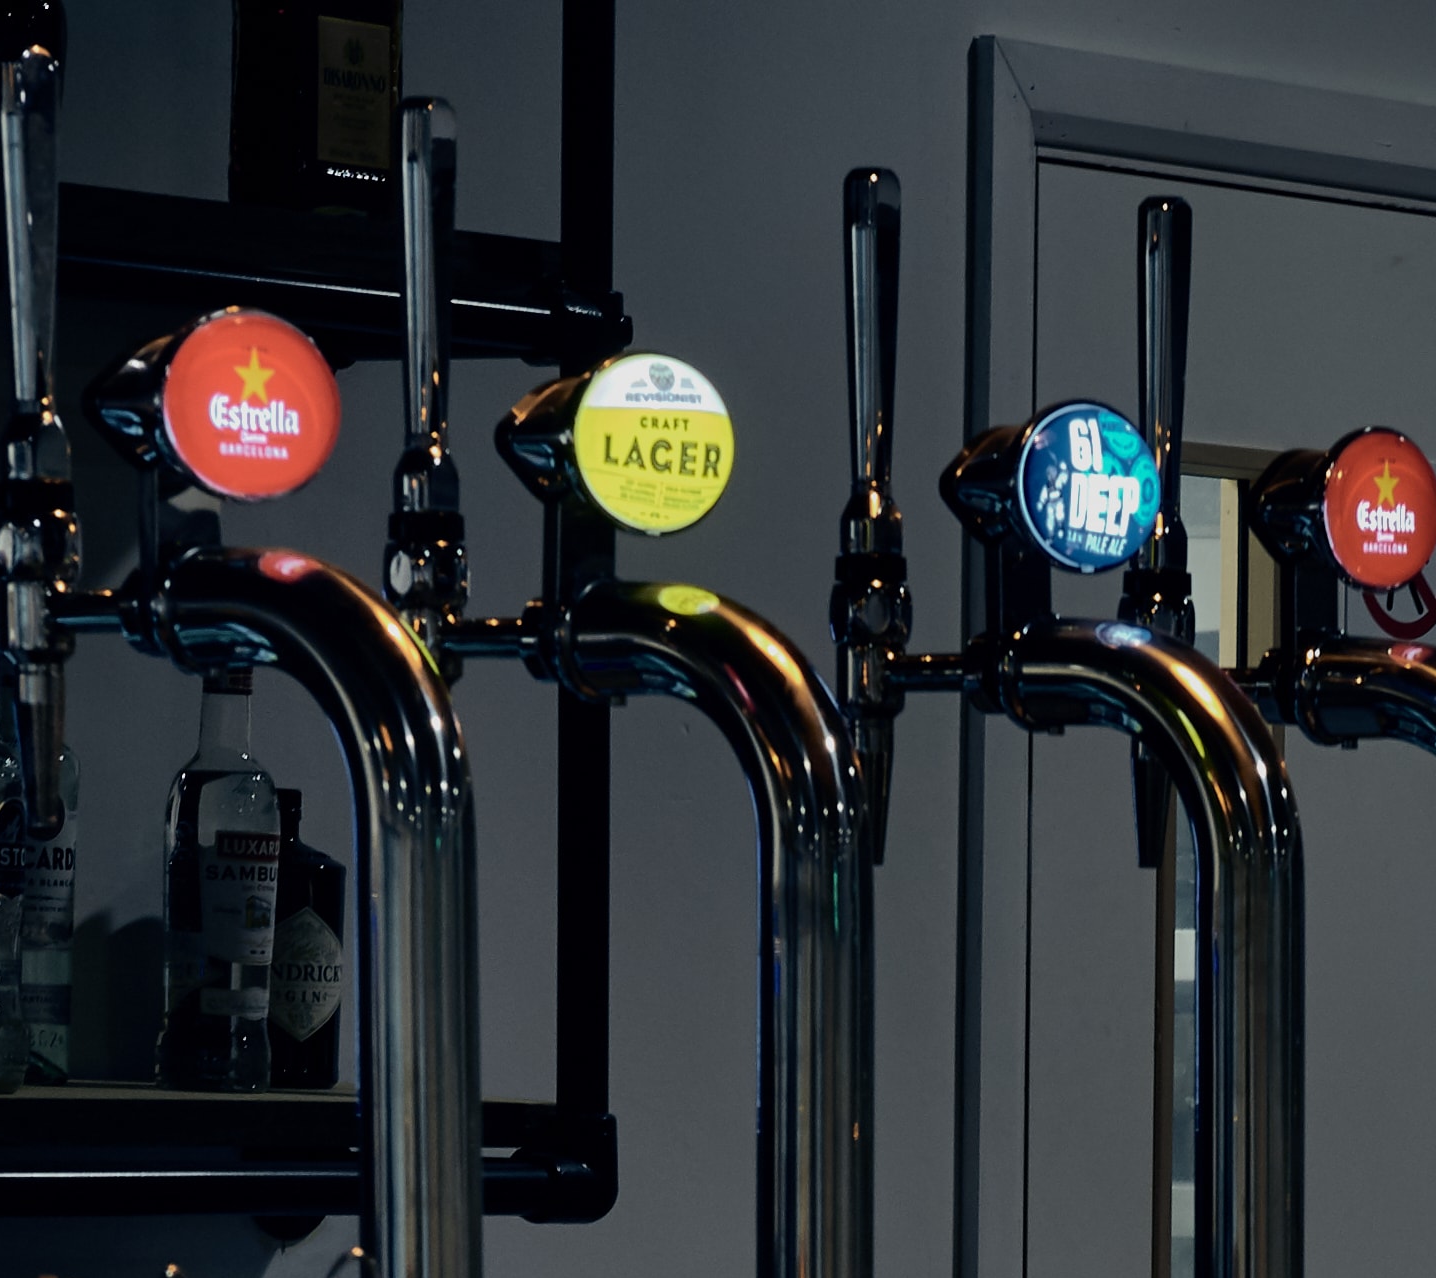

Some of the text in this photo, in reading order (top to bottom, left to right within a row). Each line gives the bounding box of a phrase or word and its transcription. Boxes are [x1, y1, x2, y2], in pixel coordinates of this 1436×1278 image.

[209, 393, 299, 435] Estrella
[640, 417, 689, 431] CRAFT
[219, 442, 289, 460] BARCELONA
[603, 433, 721, 478] LAGER
[1068, 418, 1102, 473] 61
[1068, 472, 1140, 537] DEEP
[1356, 499, 1415, 533] Estrella
[1085, 533, 1109, 555] PALE
[1108, 538, 1128, 557] ALE
[1363, 541, 1408, 555] BARCELONA
[285, 990, 321, 1003] GIN
